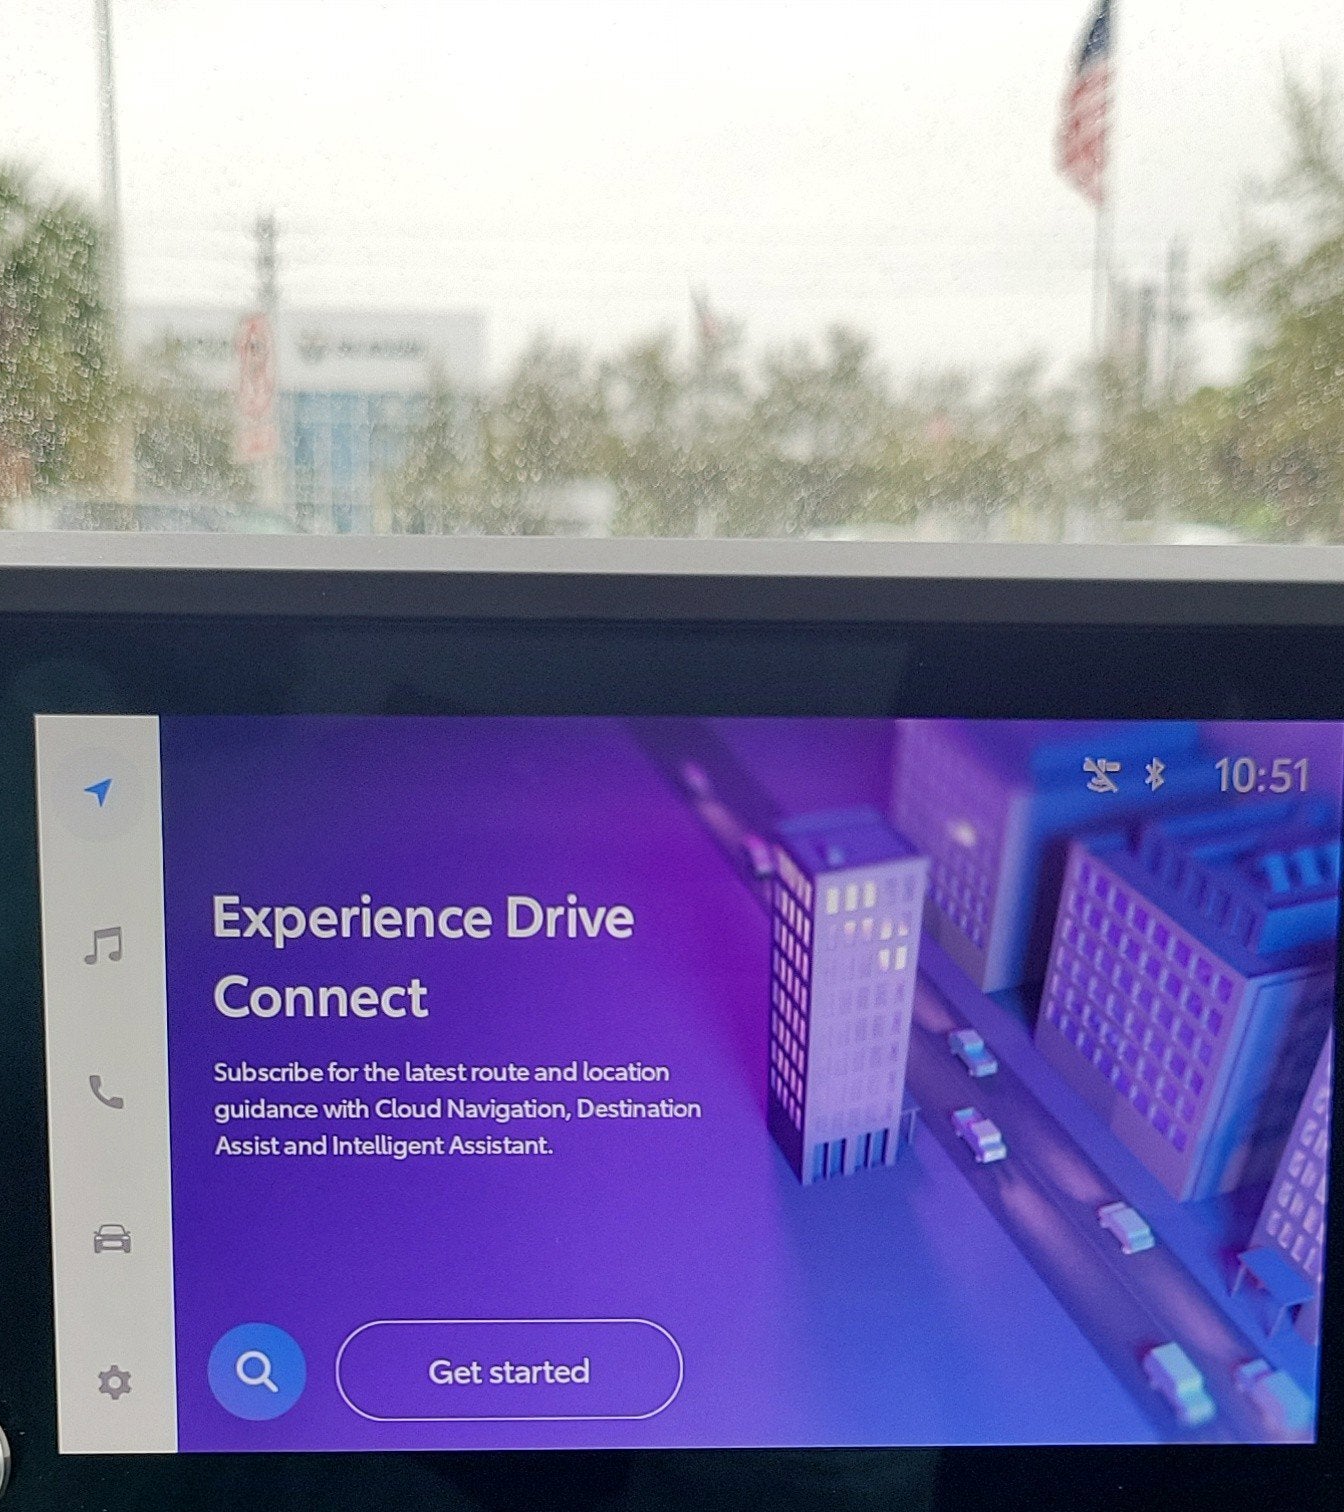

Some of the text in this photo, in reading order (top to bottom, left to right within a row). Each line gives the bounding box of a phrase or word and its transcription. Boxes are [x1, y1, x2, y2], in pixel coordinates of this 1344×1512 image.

[1215, 758, 1309, 793] 10:51
[213, 893, 635, 948] Experience Drive
[213, 974, 429, 1018] Connect
[213, 1062, 669, 1083] Subscribe for the latest route and location
[214, 1098, 701, 1125] guidance with Cloud Navigation, Destination
[215, 1135, 553, 1159] Assist and Intelligent Assistant.
[429, 1359, 590, 1385] Get started
